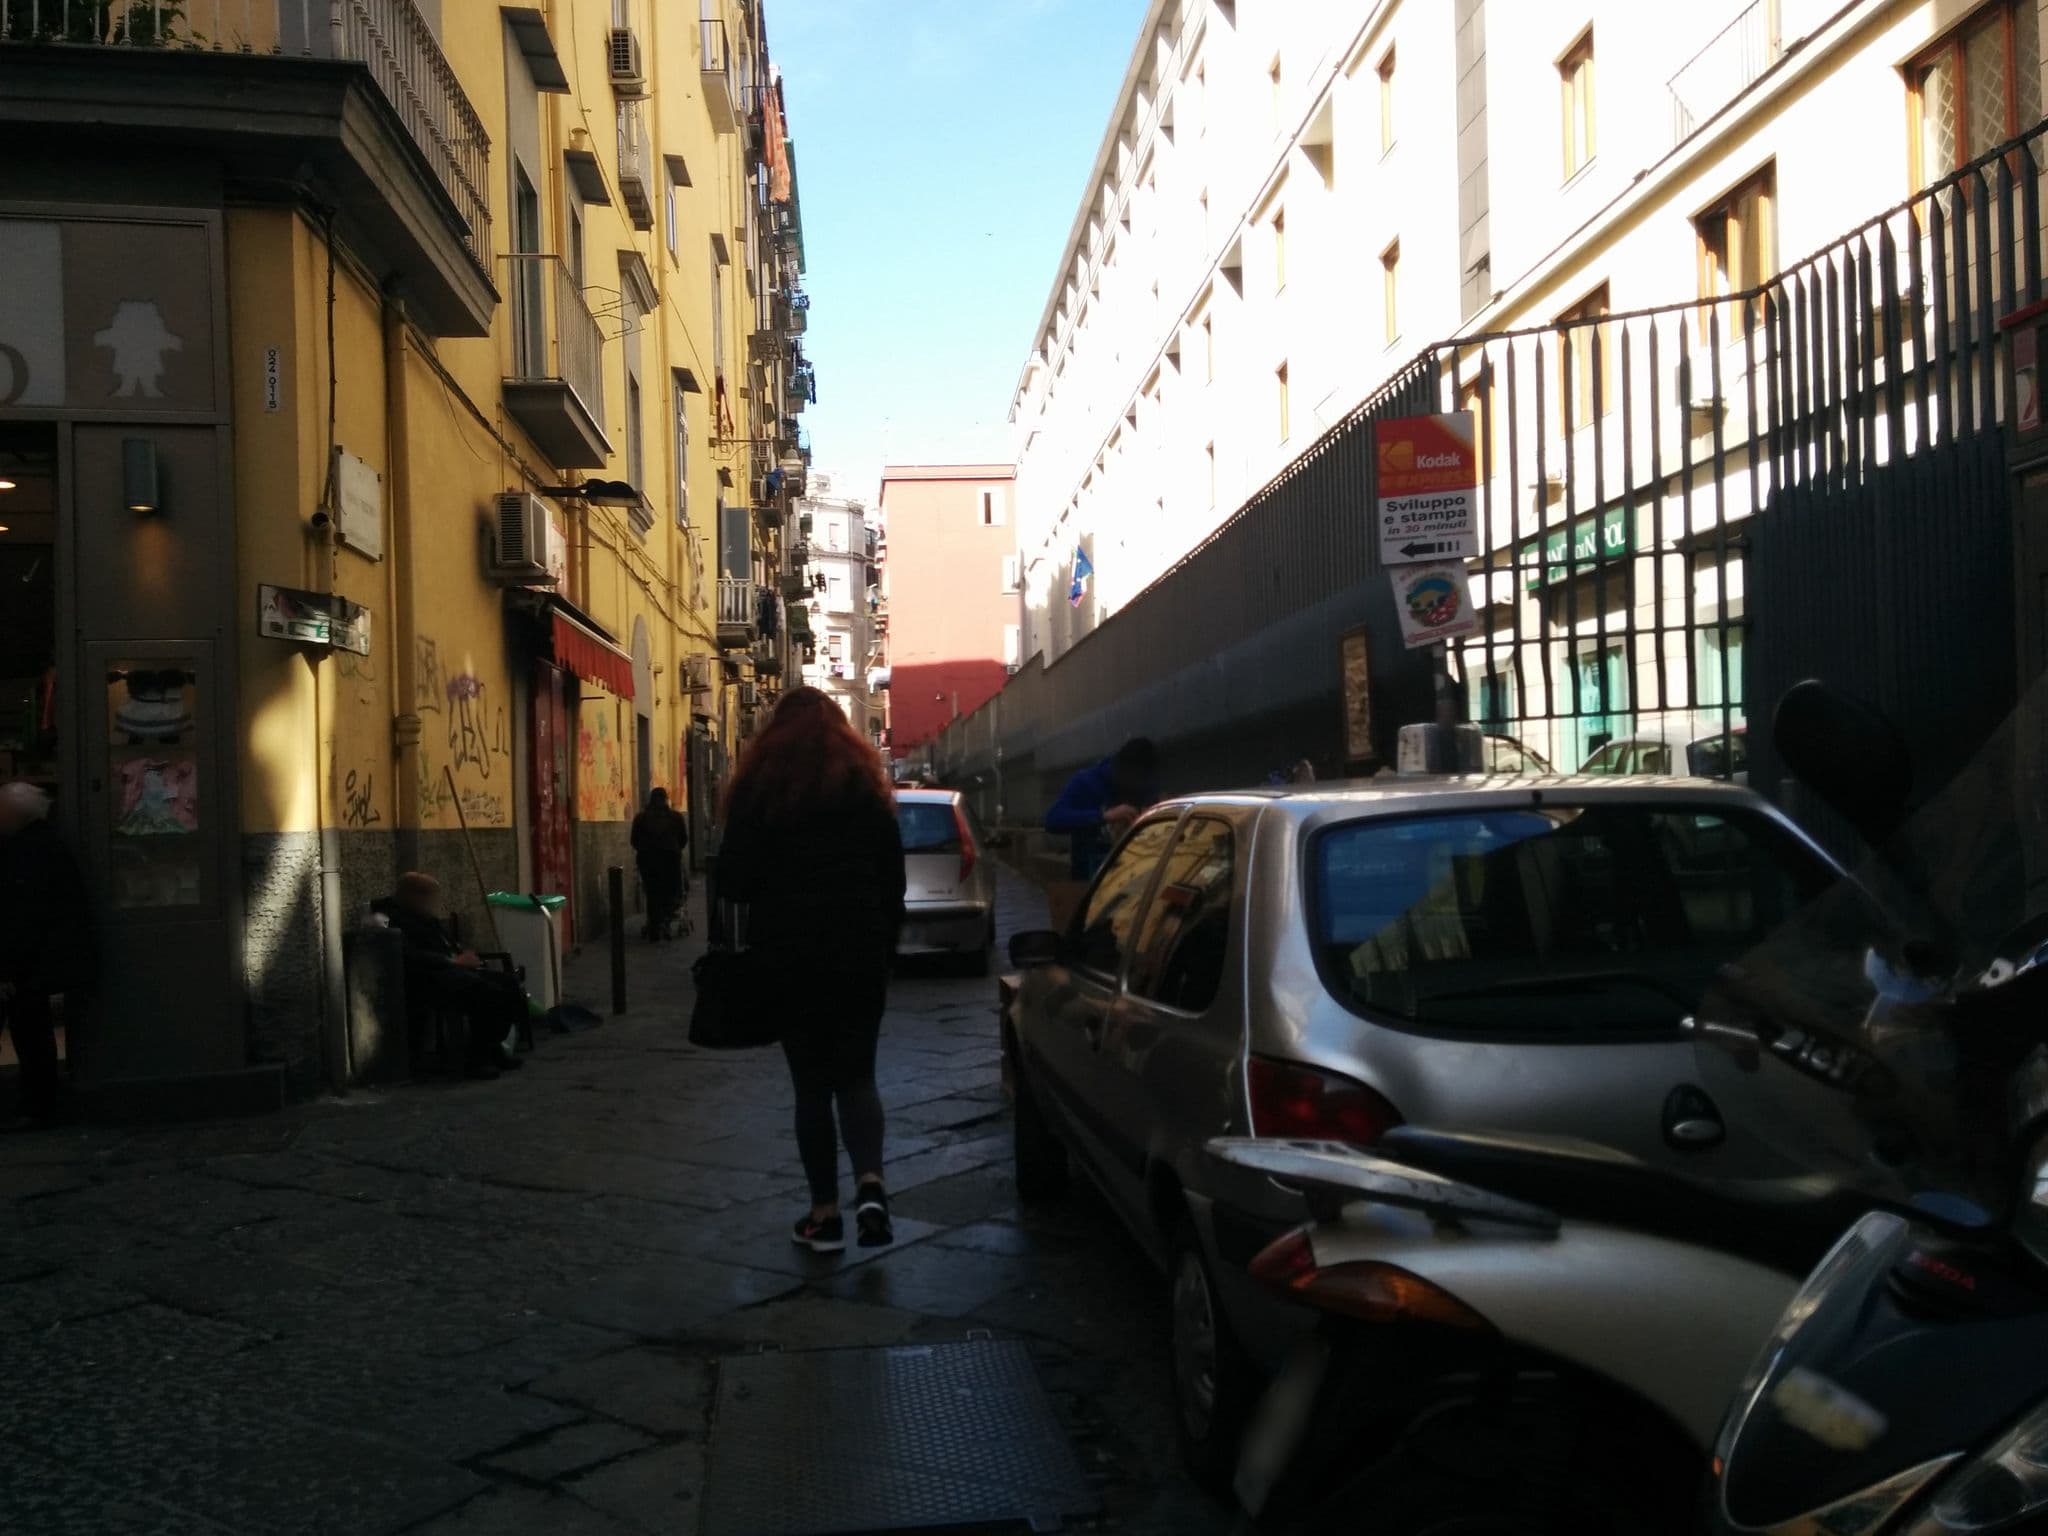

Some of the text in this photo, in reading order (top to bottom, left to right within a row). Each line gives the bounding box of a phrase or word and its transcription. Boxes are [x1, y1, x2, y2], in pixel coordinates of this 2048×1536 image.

[1416, 451, 1461, 470] Kodak
[1386, 495, 1466, 513] Sviluppo
[1384, 508, 1468, 525] e stampa
[1387, 524, 1401, 536] in
[1423, 518, 1468, 533] minuti
